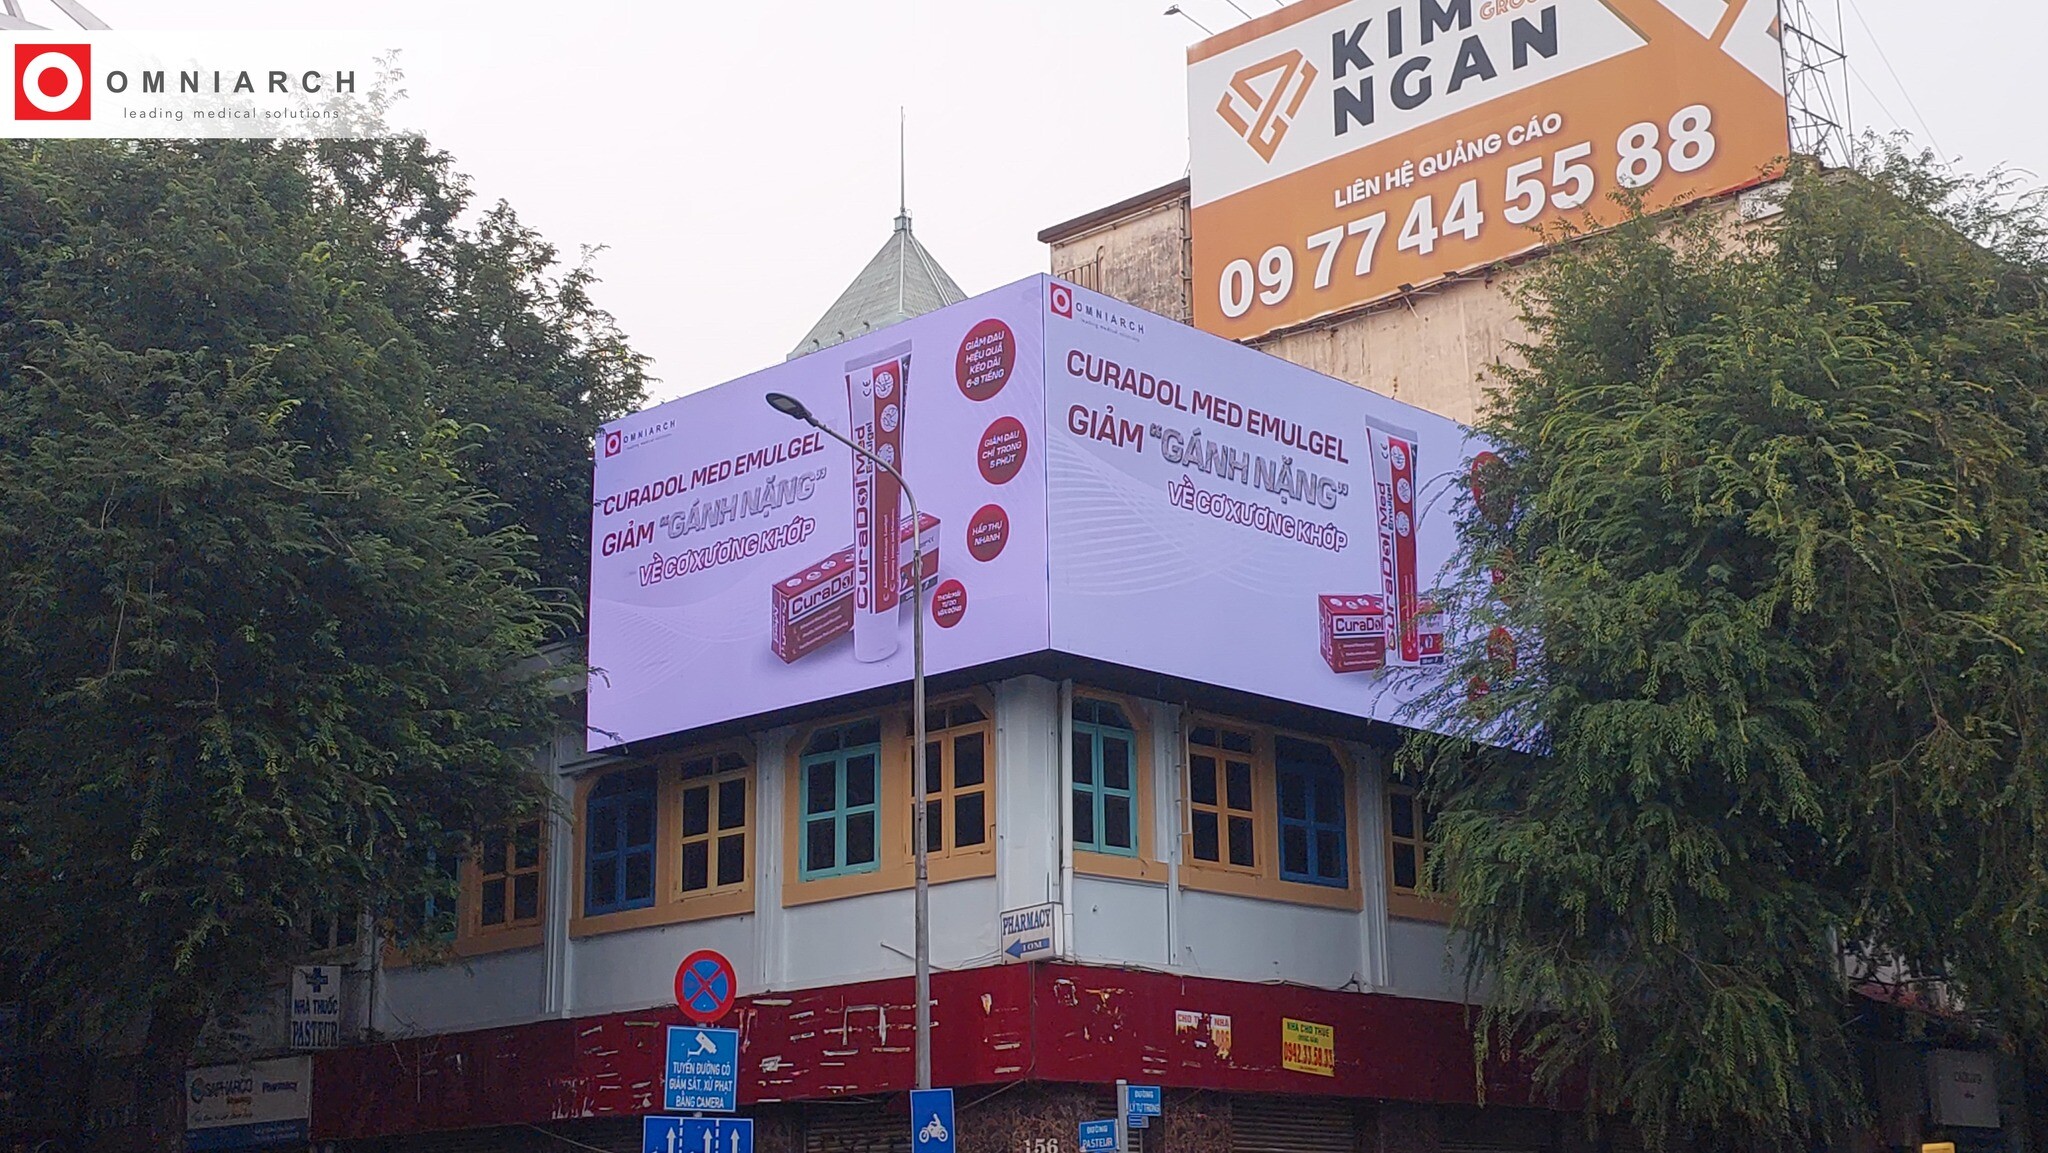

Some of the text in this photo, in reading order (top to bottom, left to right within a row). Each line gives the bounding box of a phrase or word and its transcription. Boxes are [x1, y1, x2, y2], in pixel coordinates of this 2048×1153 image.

[1332, 0, 1473, 81] KIM
[1333, 5, 1558, 137] NGAN
[1333, 113, 1562, 208] LIÊN HỆ QUẢNG CÁO
[1219, 104, 1716, 318] 09 77 44 55 88
[1076, 302, 1145, 335] OMNIARCH
[1066, 350, 1349, 464] CURADOL MED EMULGEL
[623, 419, 676, 443] OMNIARCH
[1068, 404, 1144, 453] GIẢM
[854, 425, 865, 475] Med
[603, 431, 825, 516] CURADOL MED EMULGEL
[1168, 474, 1195, 511] VỀ
[1297, 519, 1348, 552] KHỚP
[1377, 481, 1389, 528] Med
[1386, 482, 1395, 532] Emulgel
[602, 520, 655, 557] GIẢM
[760, 516, 816, 553] KHỚP
[1003, 908, 1051, 936] PHARMACY
[292, 1020, 338, 1047] PASTEUR
[669, 1076, 686, 1090] GIÁM
[714, 1080, 733, 1095] PHẠT
[673, 1058, 731, 1076] TUYẾN ĐƯỜNG CÓ
[696, 1096, 724, 1108] CAMERA
[1024, 1138, 1059, 1153] 156
[1082, 1137, 1113, 1149] PASTEUR
